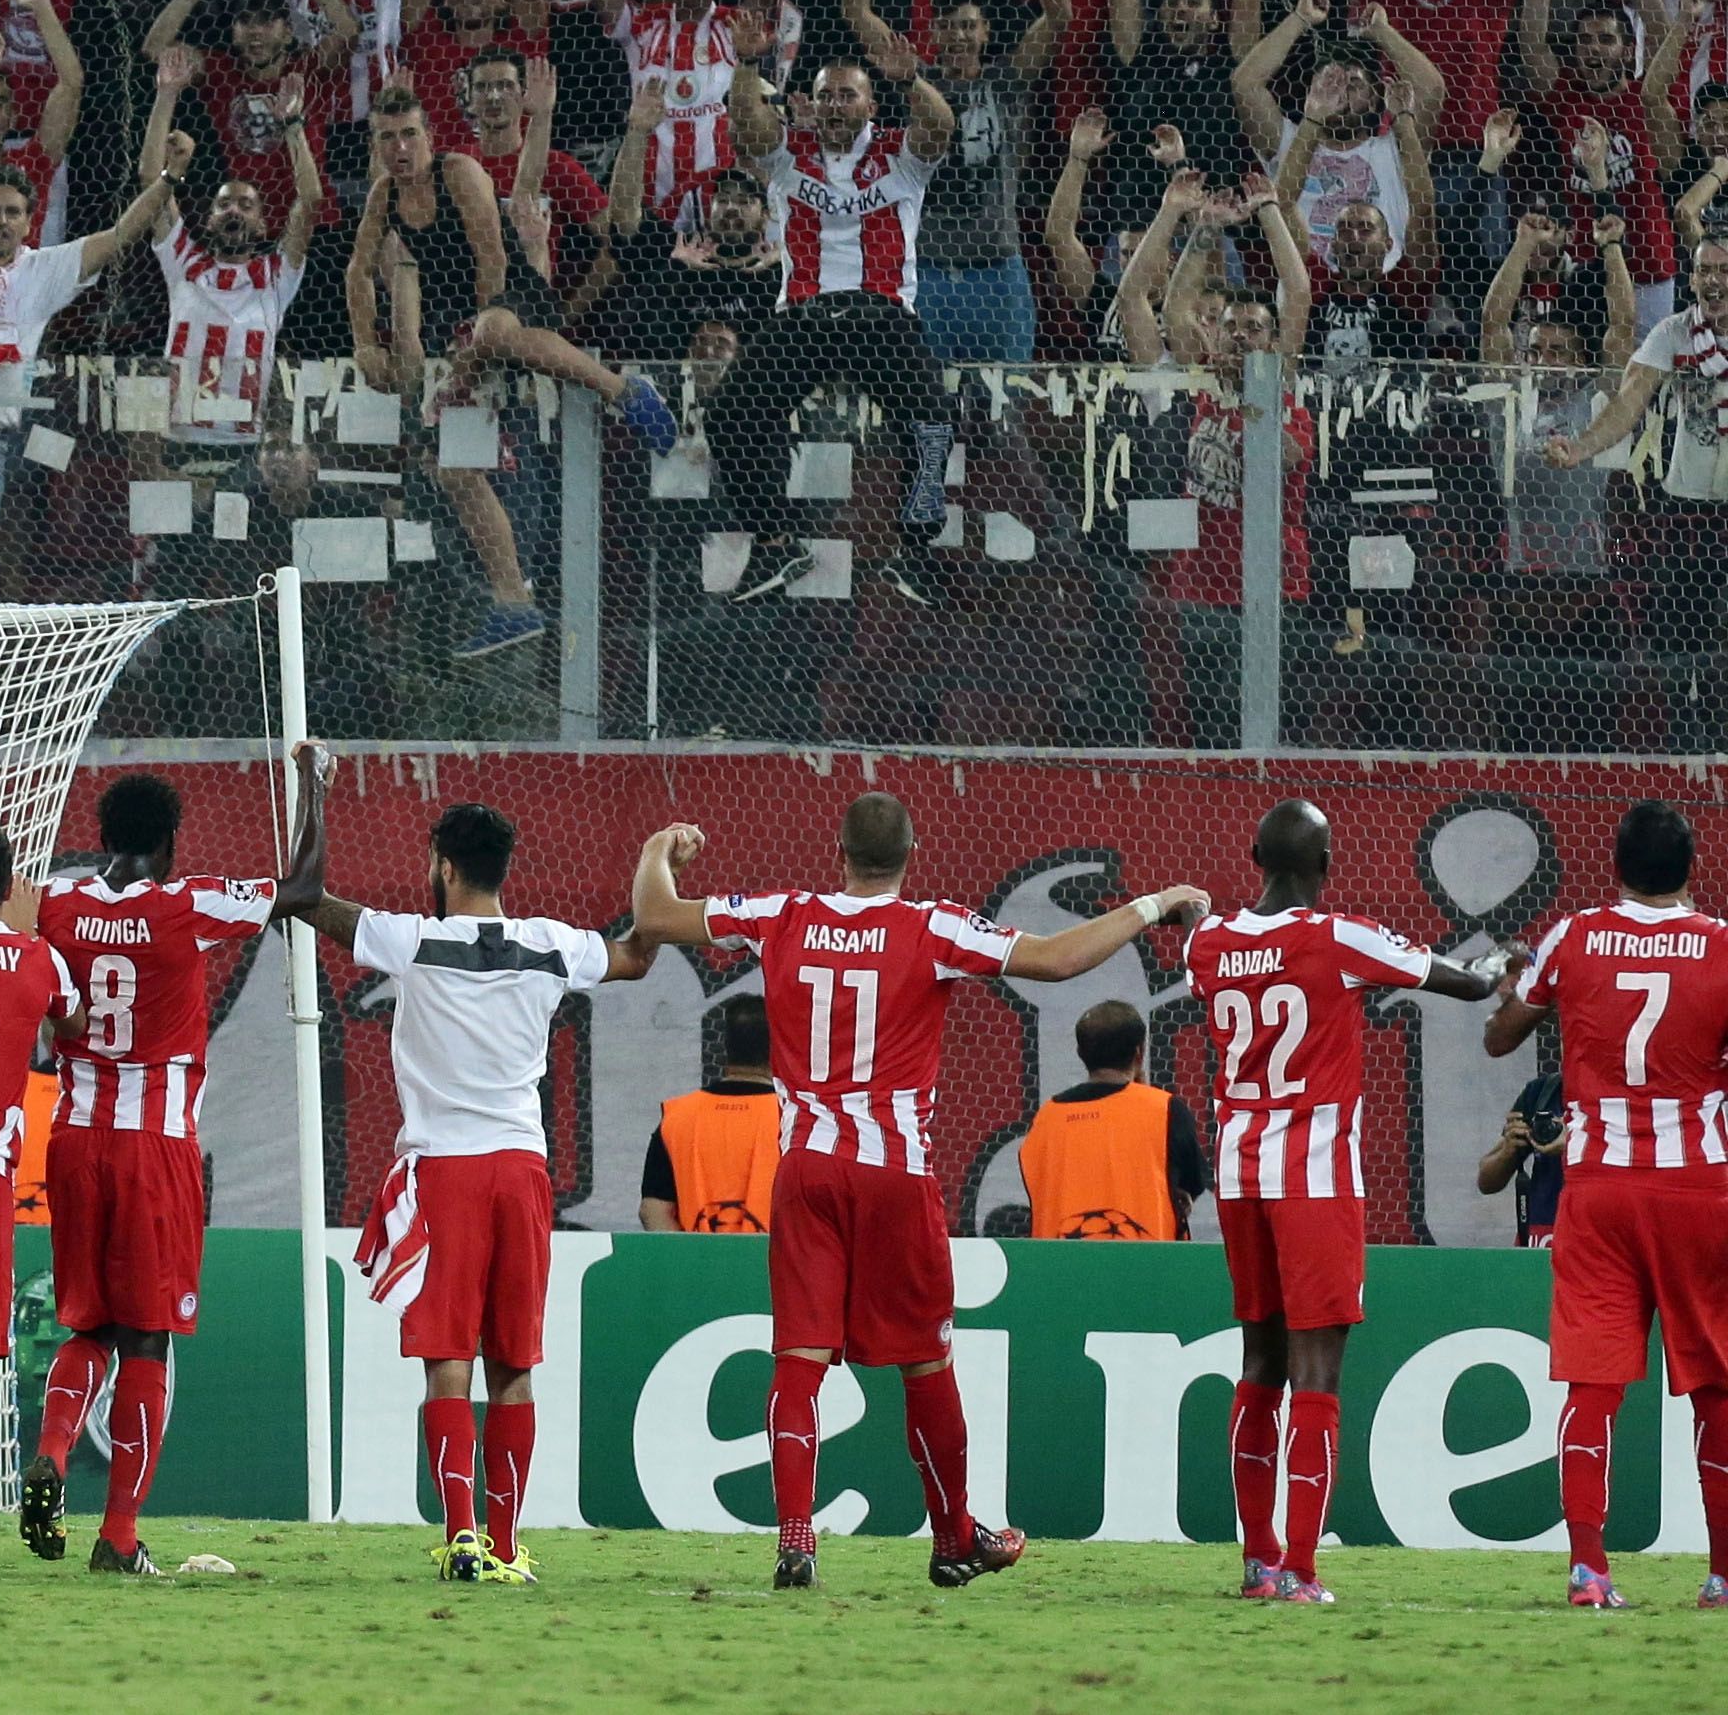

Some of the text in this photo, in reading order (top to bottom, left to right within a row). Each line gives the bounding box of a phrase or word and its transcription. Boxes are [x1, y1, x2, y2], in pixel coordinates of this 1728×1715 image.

[663, 102, 725, 120] dafone
[74, 916, 151, 945] NDINGA
[803, 924, 887, 955] KASAMI
[1585, 929, 1708, 961] MITROGLOU
[1217, 946, 1285, 979] ABIDAL
[86, 954, 137, 1061] 8
[796, 965, 880, 1083] 11
[1212, 982, 1310, 1100] 22
[1614, 971, 1671, 1086] 7
